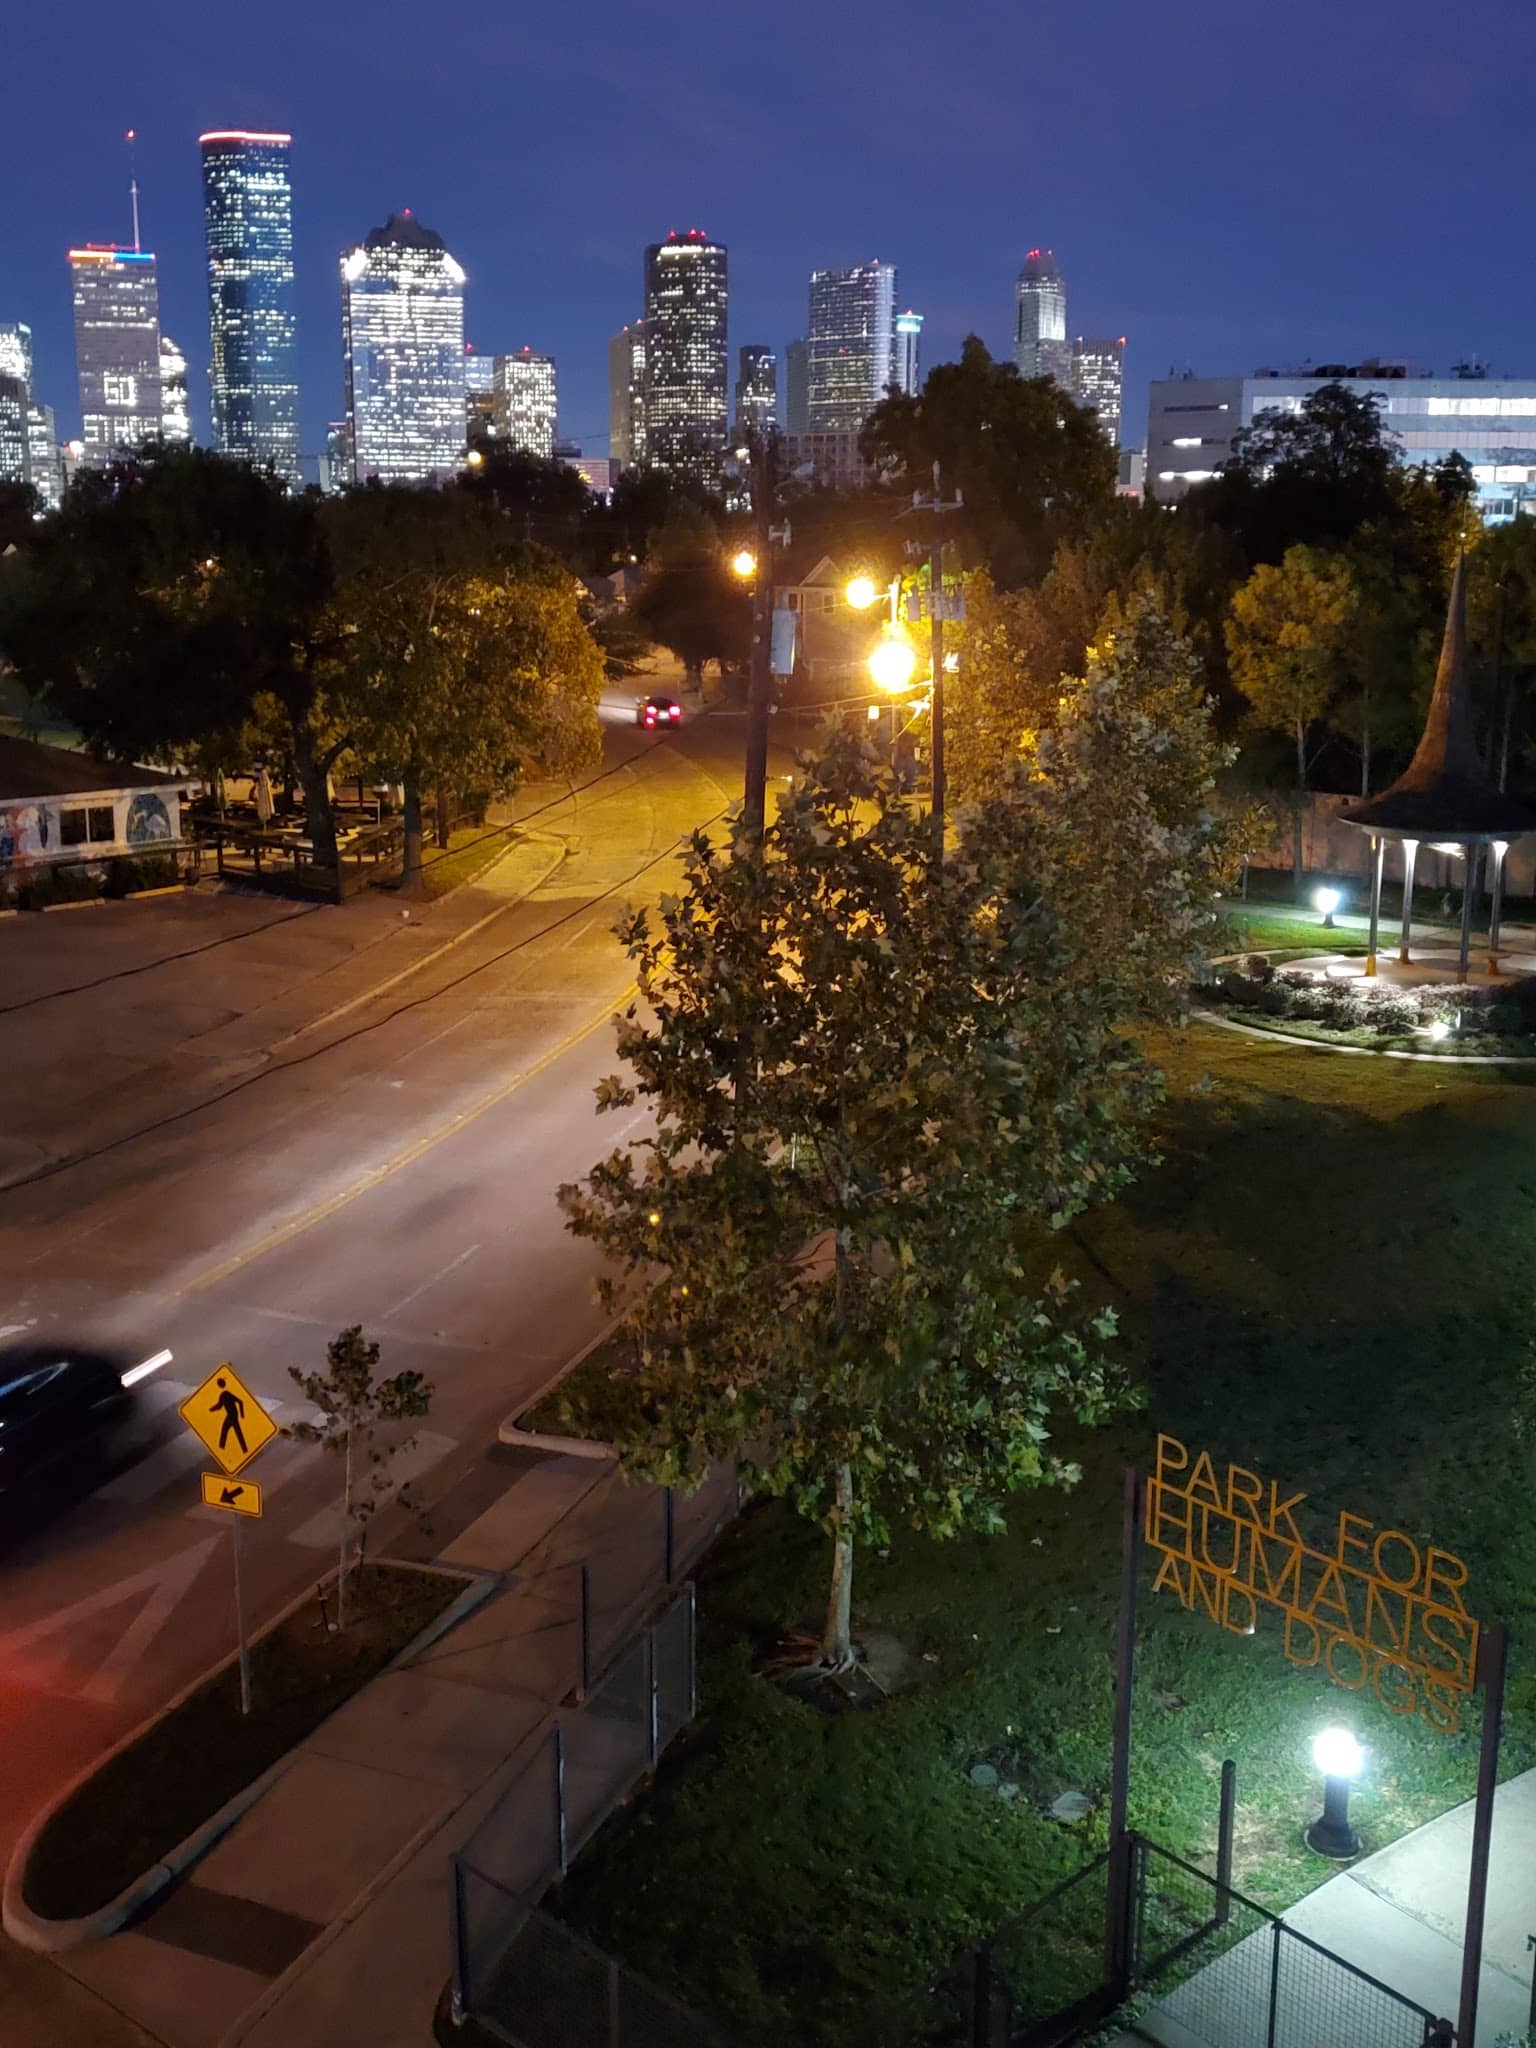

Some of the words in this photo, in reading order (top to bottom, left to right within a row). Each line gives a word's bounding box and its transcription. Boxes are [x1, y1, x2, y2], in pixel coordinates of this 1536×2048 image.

[1154, 1481, 1466, 1680] HUMANS
[1156, 1433, 1306, 1547] PARK
[1337, 1511, 1468, 1618] FOR
[1152, 1552, 1257, 1635] AND
[1284, 1608, 1459, 1734] DOGS
